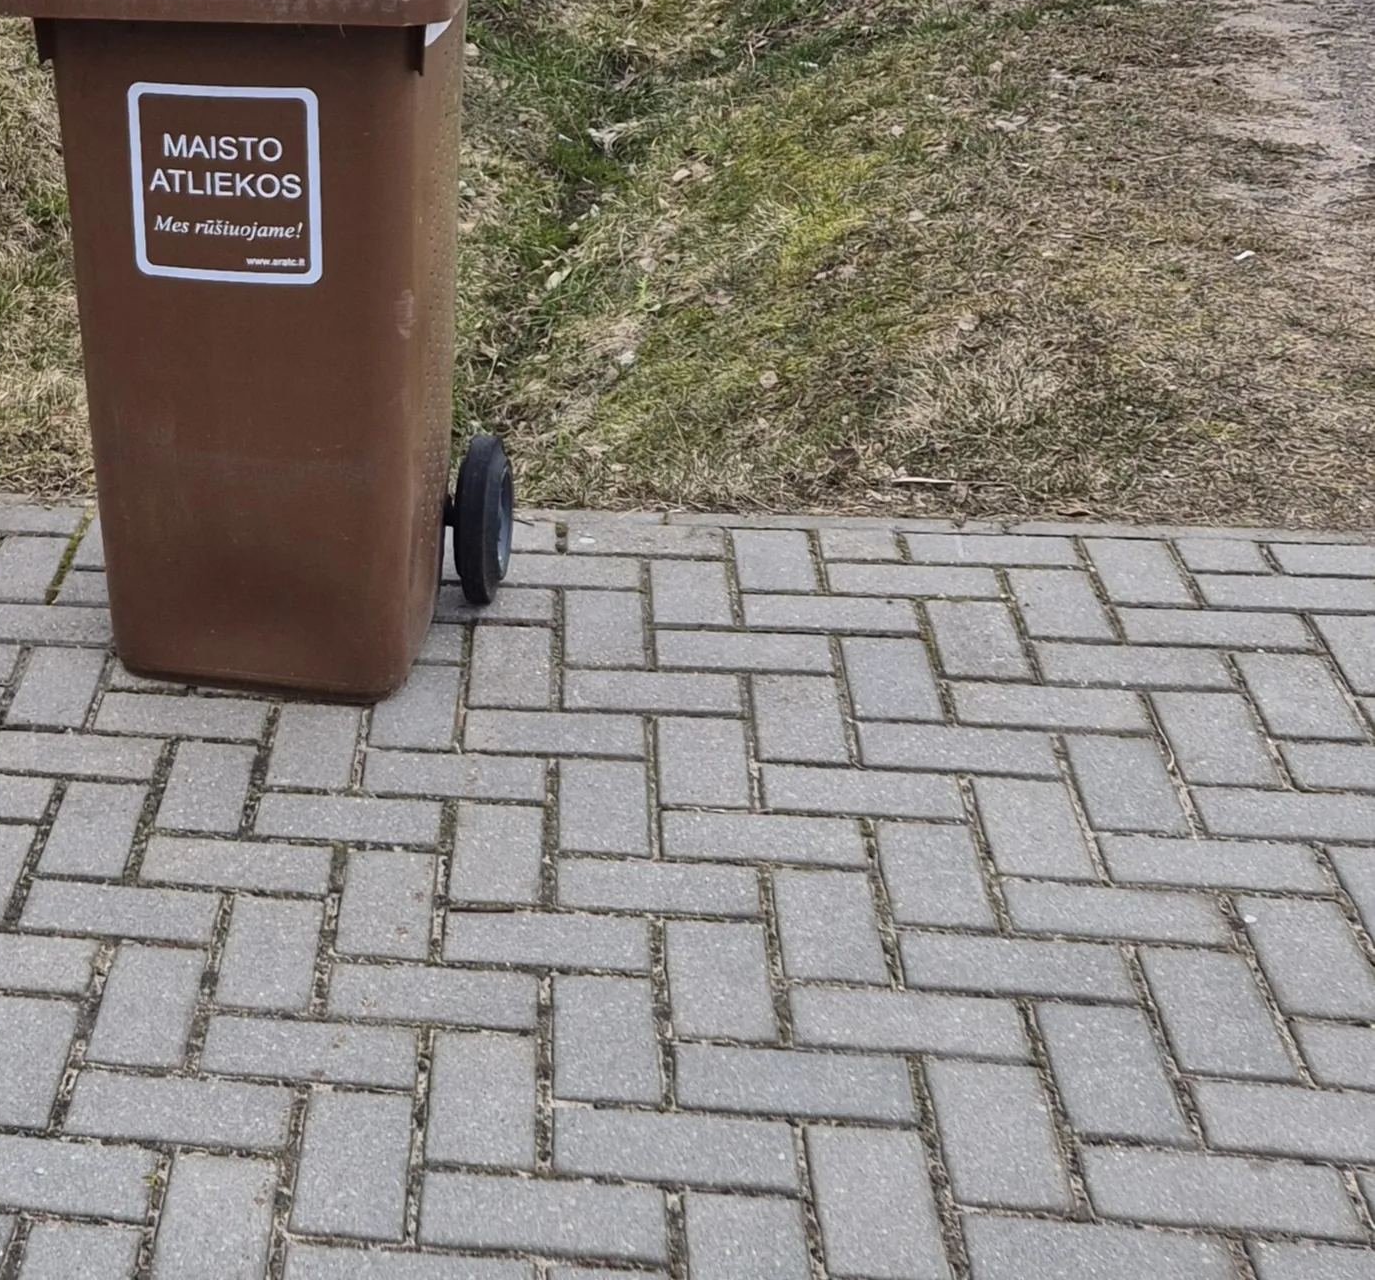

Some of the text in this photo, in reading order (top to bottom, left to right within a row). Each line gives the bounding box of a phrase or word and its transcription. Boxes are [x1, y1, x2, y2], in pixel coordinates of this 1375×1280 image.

[162, 133, 283, 162] MAISTO
[149, 168, 303, 199] ATLIEKOS
[153, 215, 303, 241] Mes rūšiuojame!
